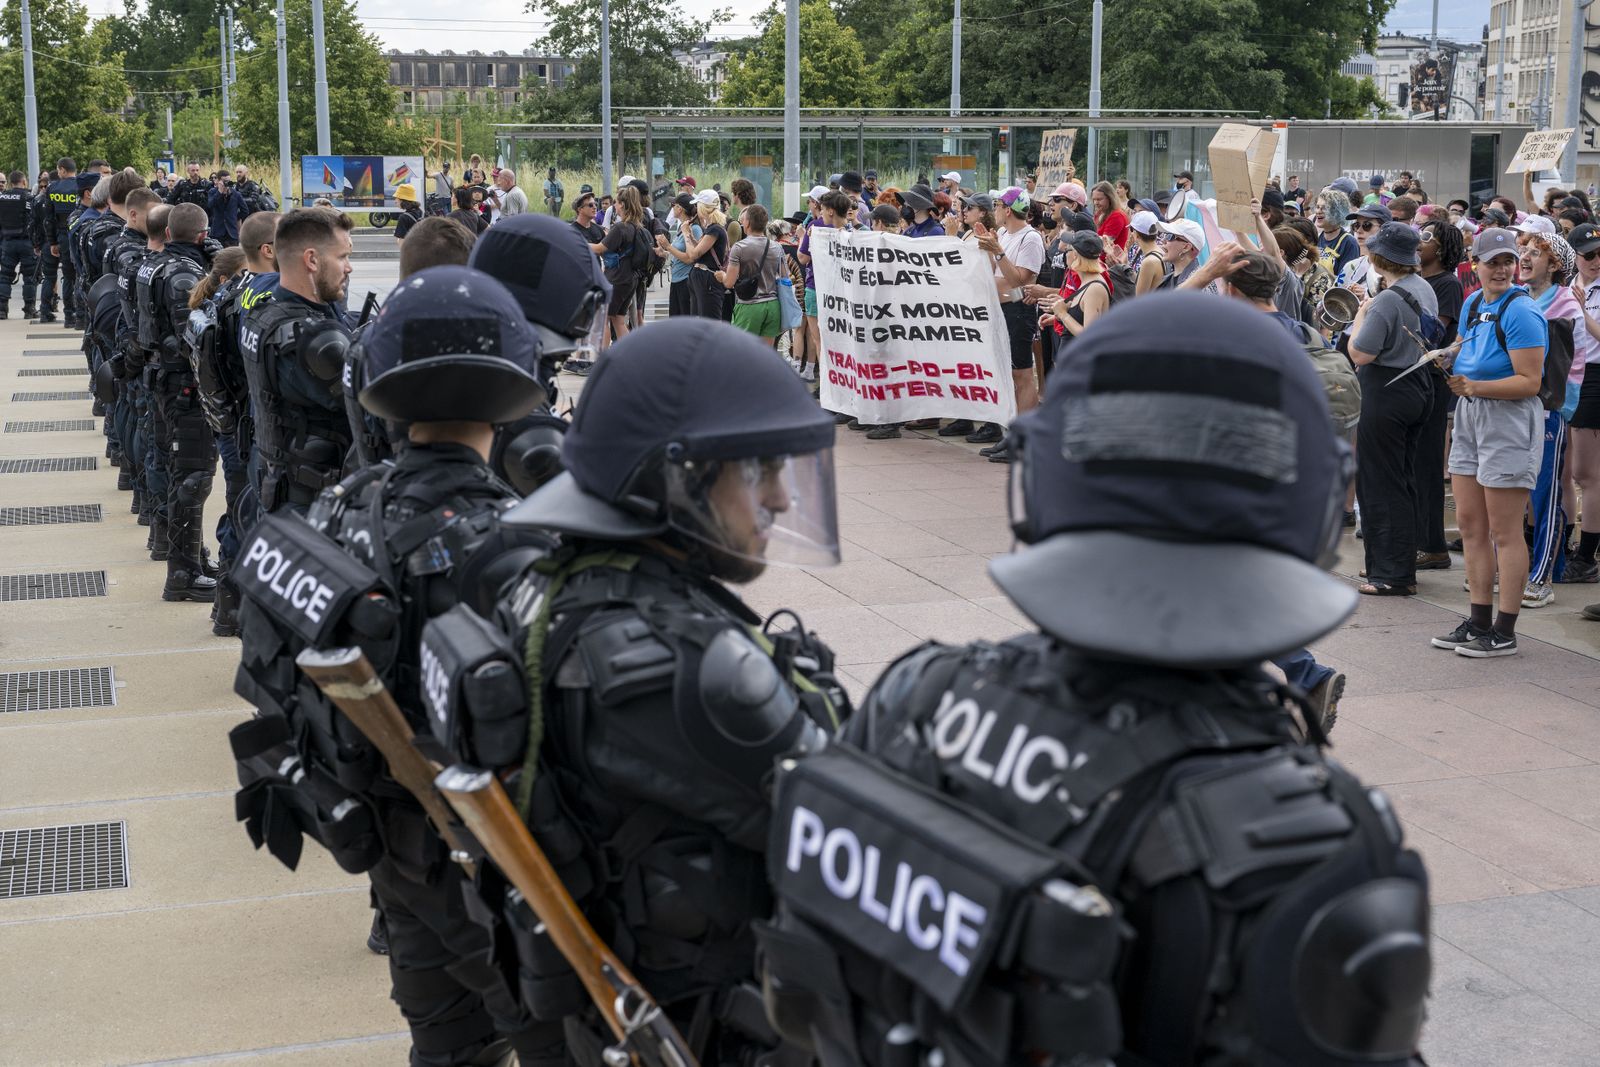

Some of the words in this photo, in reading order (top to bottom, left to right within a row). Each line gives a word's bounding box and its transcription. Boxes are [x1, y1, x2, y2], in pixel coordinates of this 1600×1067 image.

[49, 193, 76, 203] POLIC
[877, 248, 963, 267] DROITE
[859, 265, 941, 287] ÉCLATÉ
[901, 302, 989, 322] MONDE
[828, 316, 848, 334] ON
[872, 325, 984, 344] CRAMER
[242, 536, 335, 624] POLICE
[786, 805, 988, 977] POLICE
